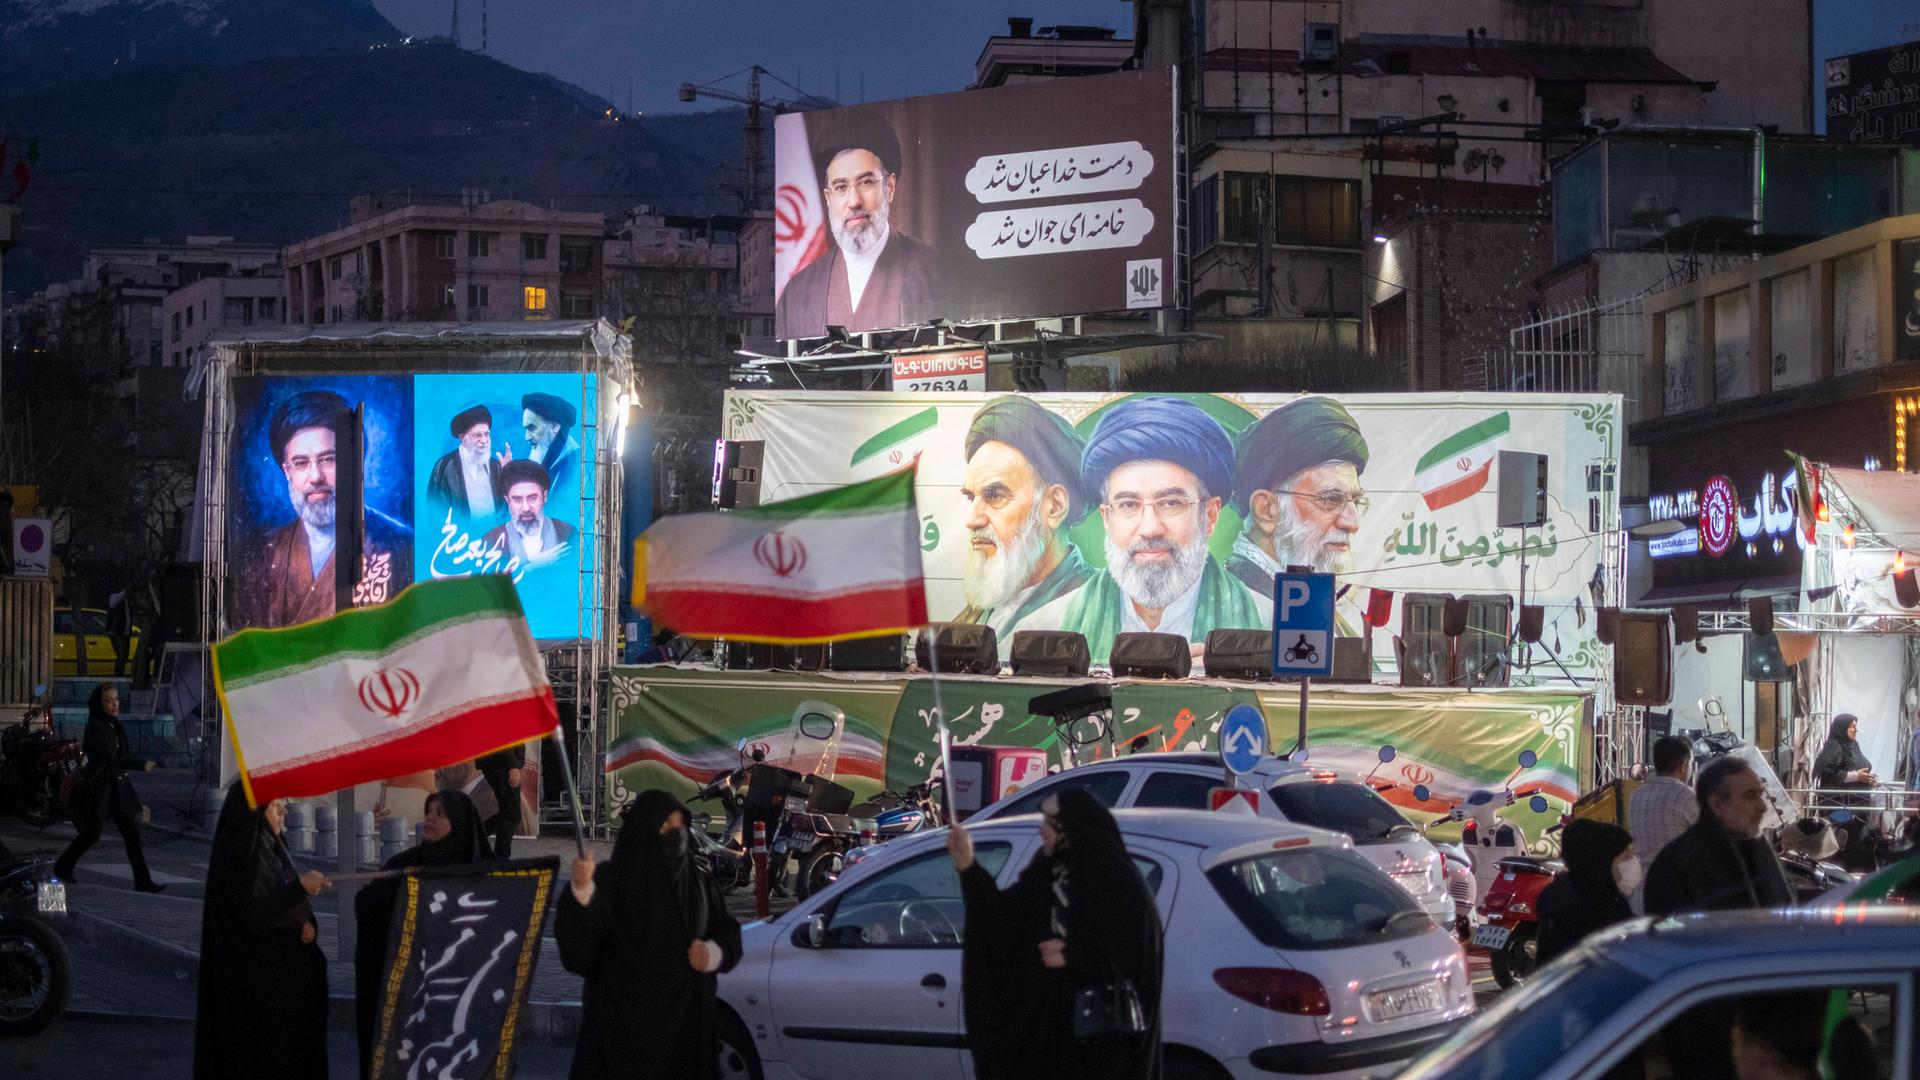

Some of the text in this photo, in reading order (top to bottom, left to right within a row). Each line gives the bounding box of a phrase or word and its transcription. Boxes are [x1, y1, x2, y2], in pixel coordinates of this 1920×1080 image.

[983, 153, 1133, 194] دست خدا عیان شد
[990, 216, 1015, 248] شد
[1016, 216, 1058, 249] جوان
[894, 355, 984, 376] کانون ایران نوین
[909, 379, 969, 392] 27634
[1280, 580, 1310, 622] P
